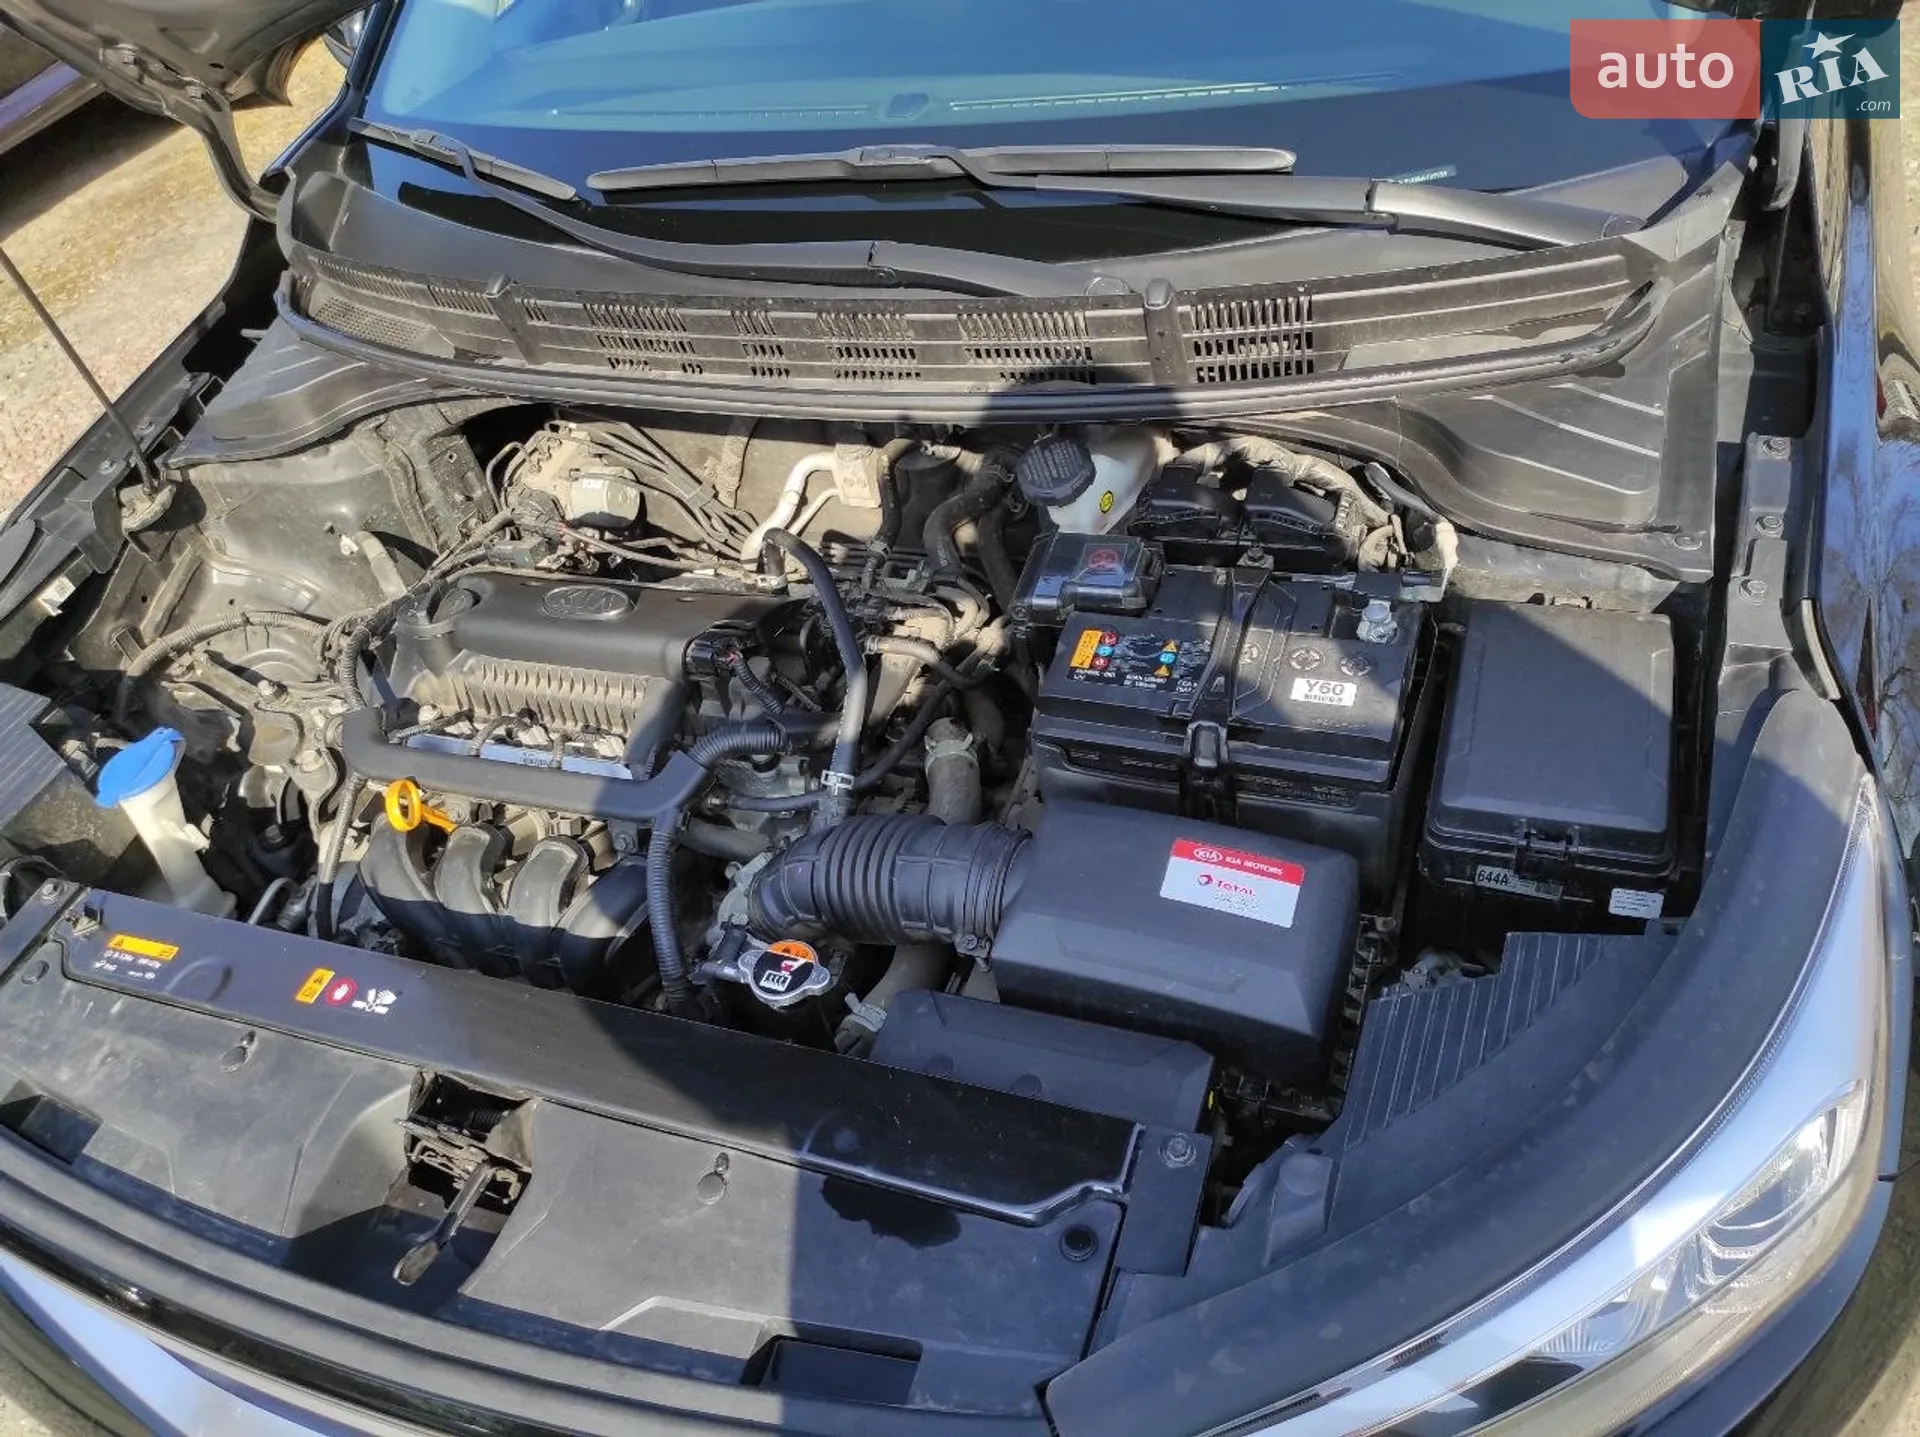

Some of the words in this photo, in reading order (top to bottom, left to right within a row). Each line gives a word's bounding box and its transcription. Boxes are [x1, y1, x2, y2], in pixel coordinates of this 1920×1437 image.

[1305, 679, 1344, 696] Y60
[1196, 848, 1221, 862] KIA
[1225, 855, 1241, 865] KIA
[1244, 861, 1283, 875] MOTORS
[1477, 869, 1508, 886] 644A
[1217, 880, 1256, 896] TOTAL
